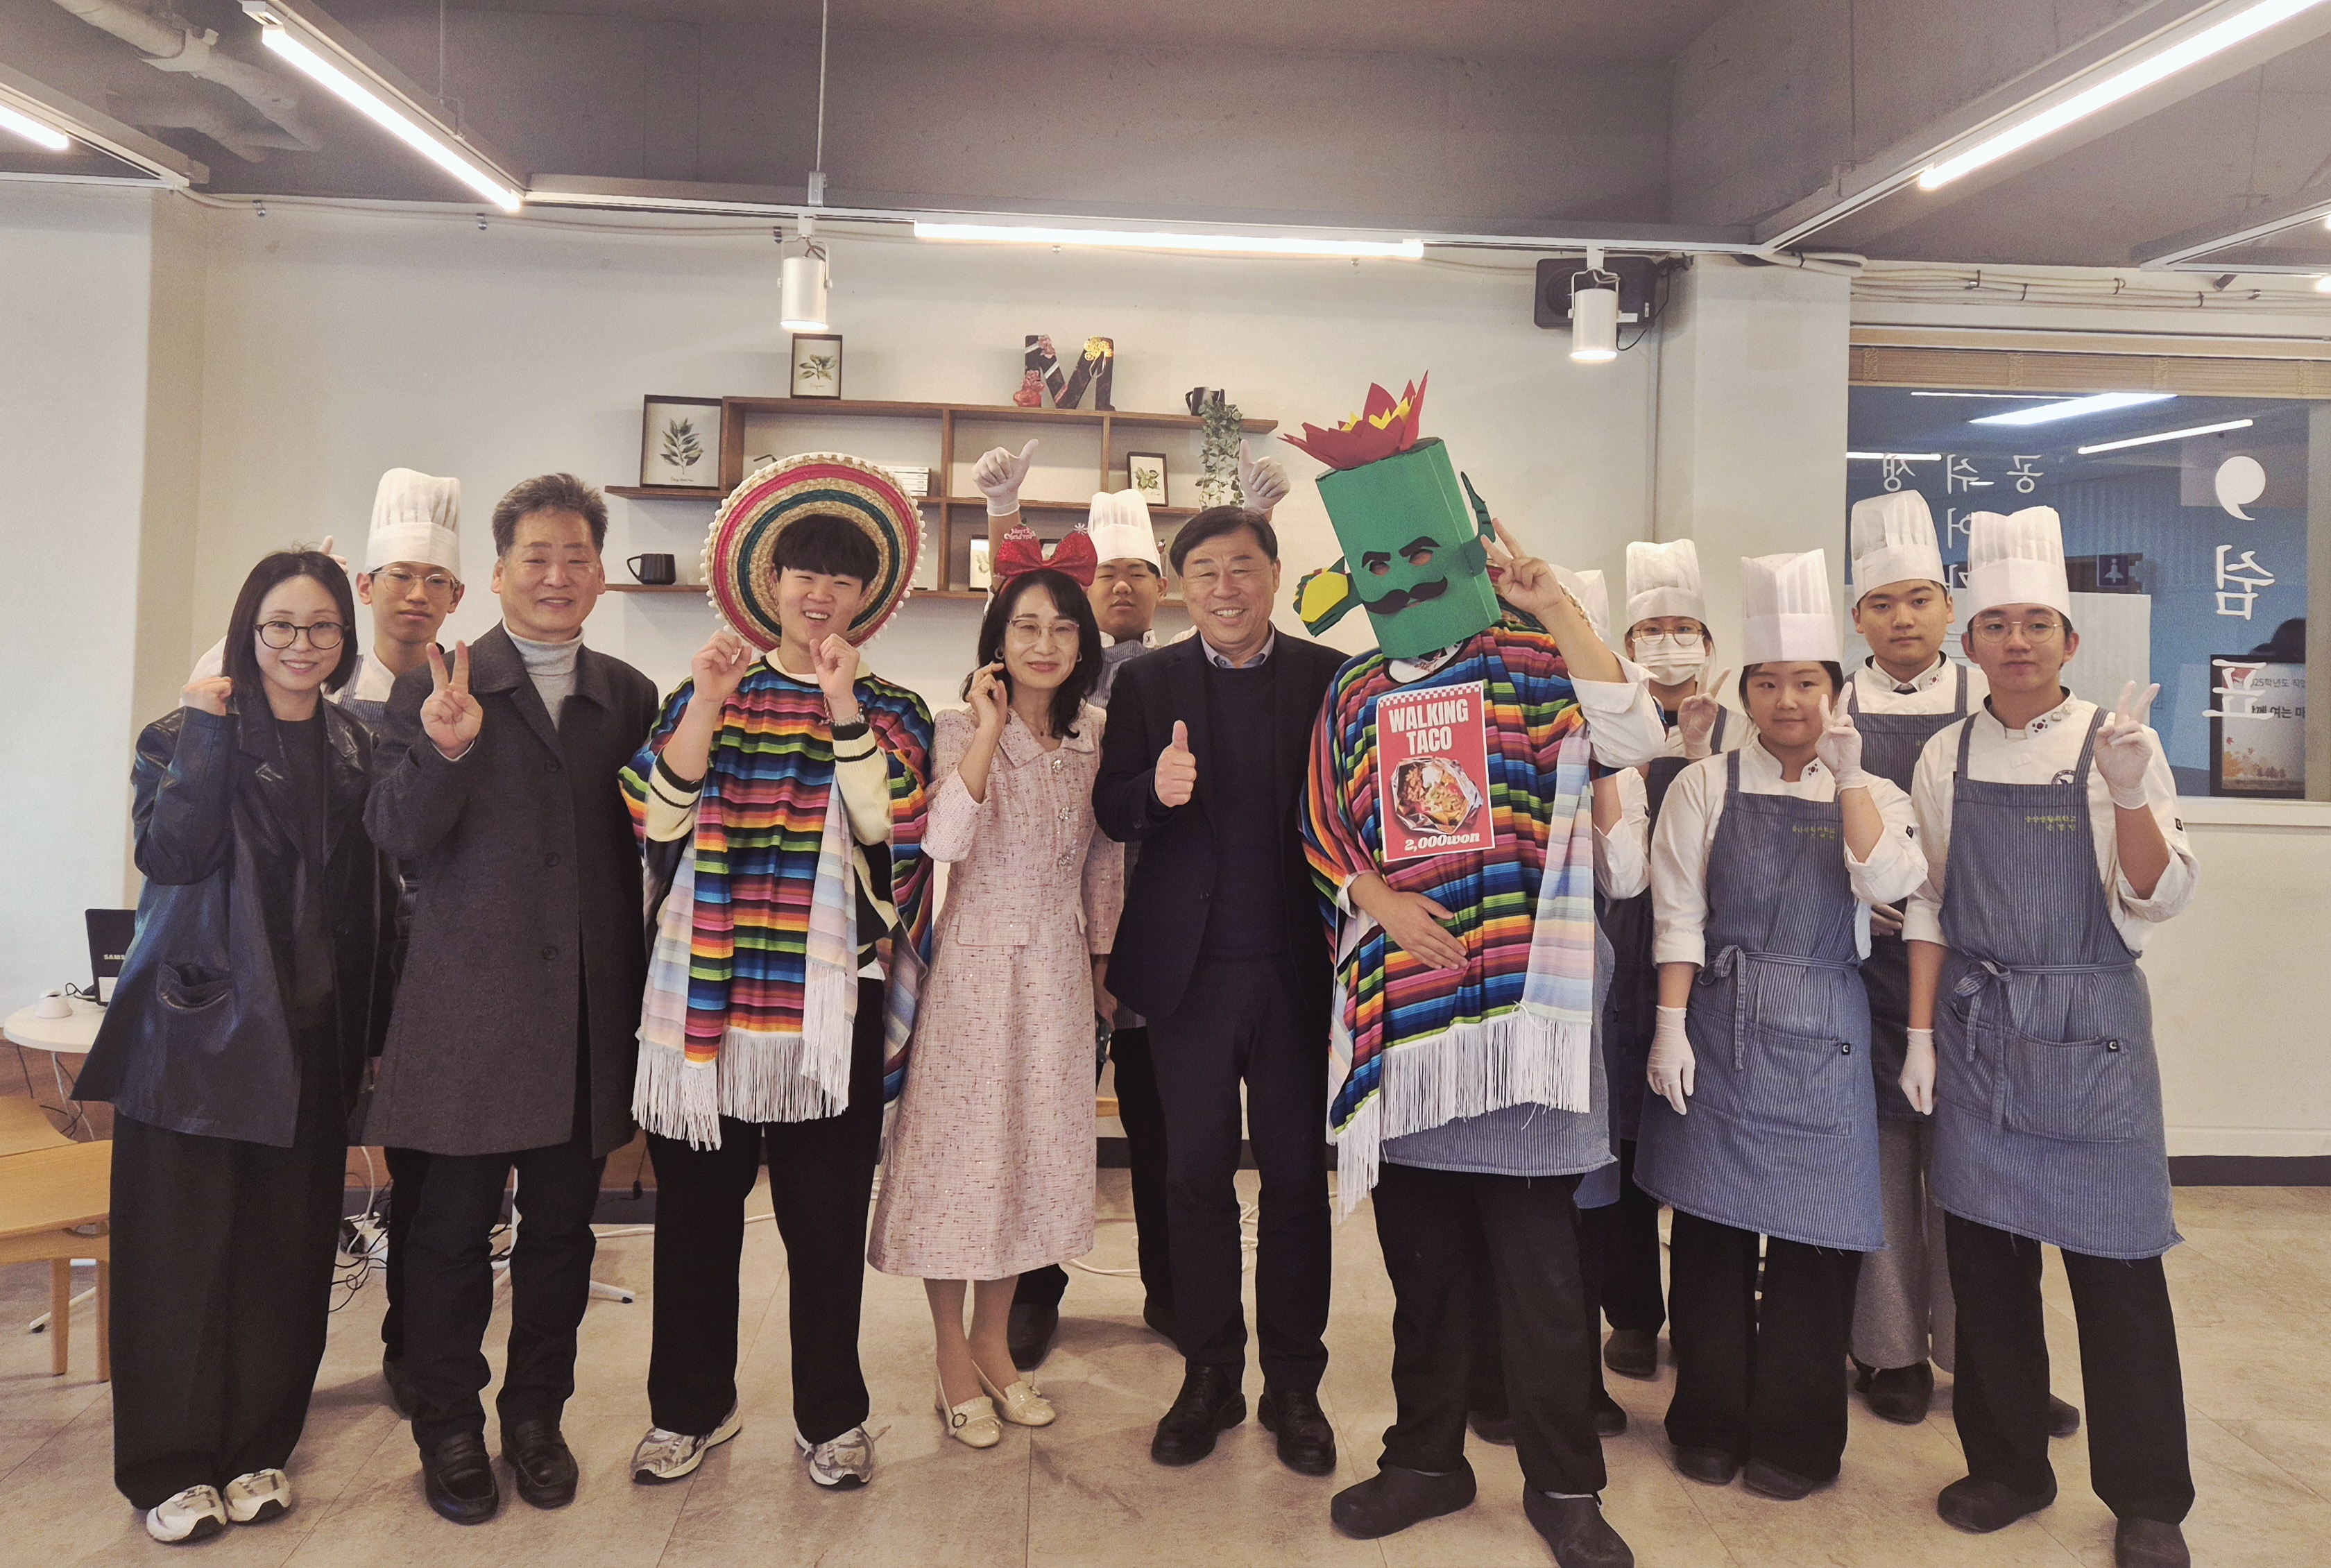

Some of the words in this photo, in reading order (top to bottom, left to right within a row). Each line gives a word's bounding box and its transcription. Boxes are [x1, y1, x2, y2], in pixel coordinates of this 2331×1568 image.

[2251, 679, 2289, 688] 25학년도
[1389, 699, 1469, 733] WALKING
[2270, 706, 2292, 719] 여는
[1406, 726, 1452, 756] TACO
[1404, 833, 1480, 852] 2,000won
